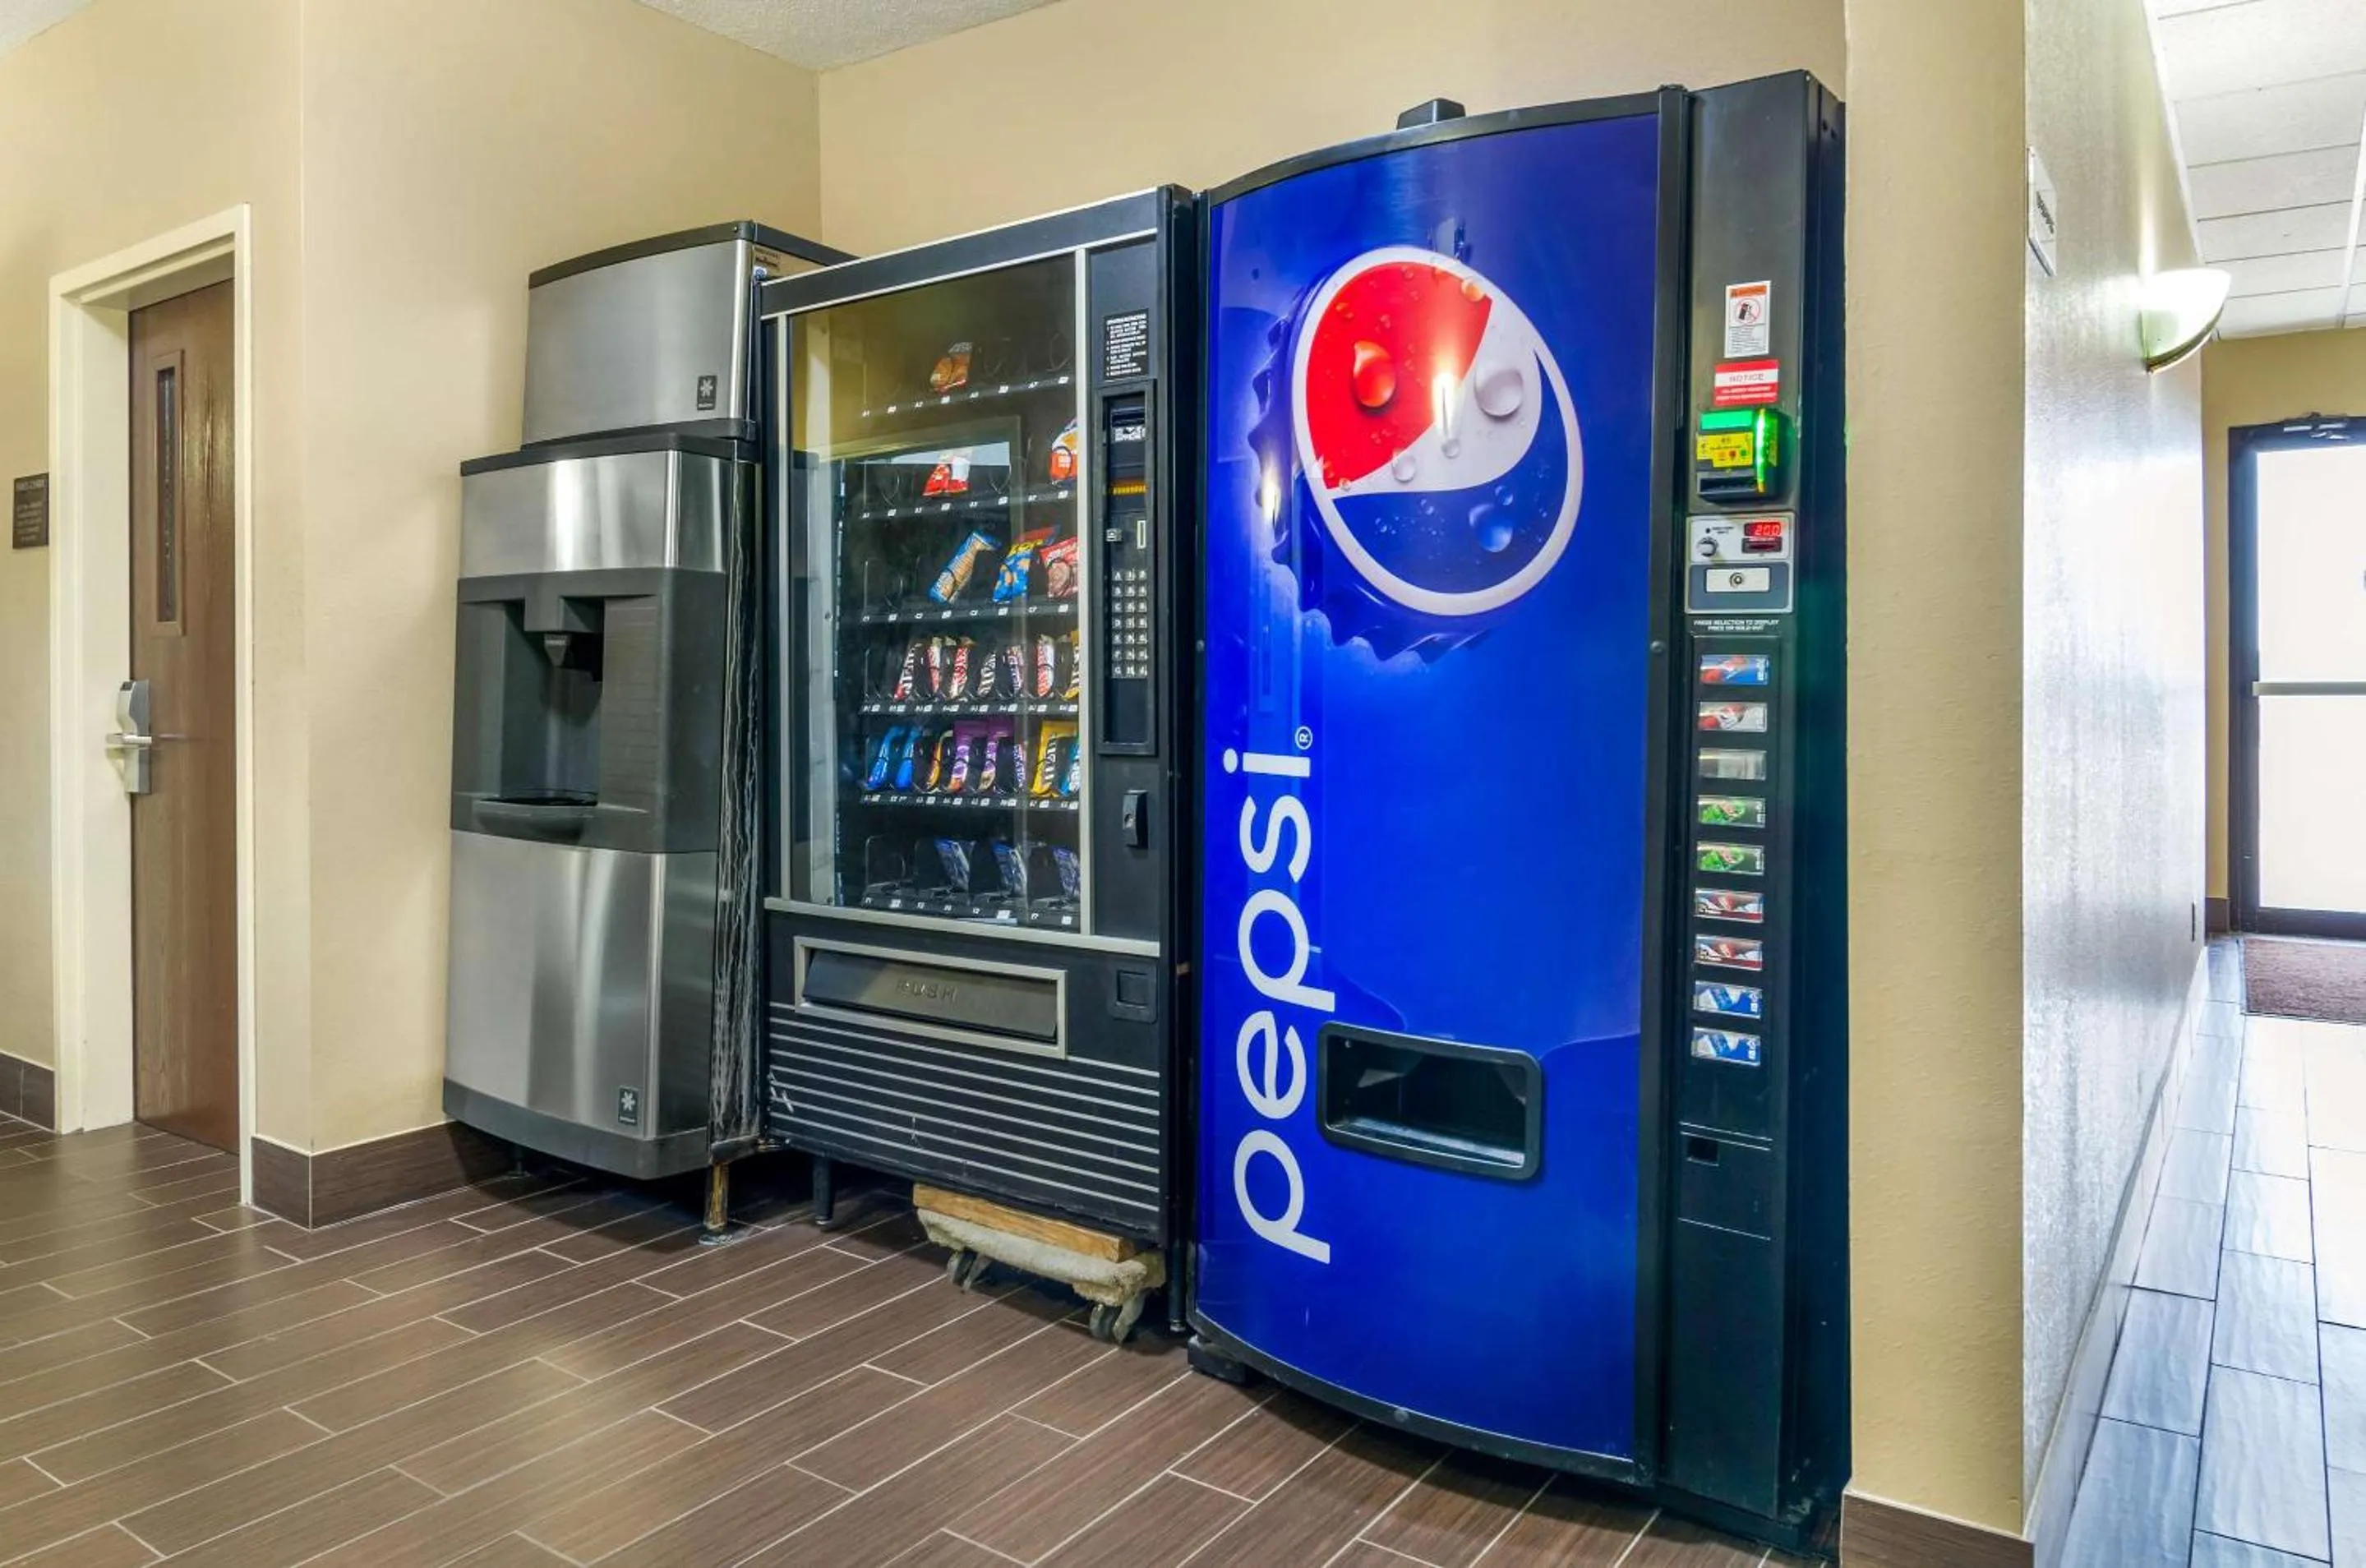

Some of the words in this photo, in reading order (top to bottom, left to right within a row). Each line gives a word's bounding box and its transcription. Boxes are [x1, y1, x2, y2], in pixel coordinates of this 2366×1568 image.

[1728, 373, 1764, 382] NOTICE
[895, 979, 957, 1002] PUSH
[1223, 748, 1335, 1265] pepsi
